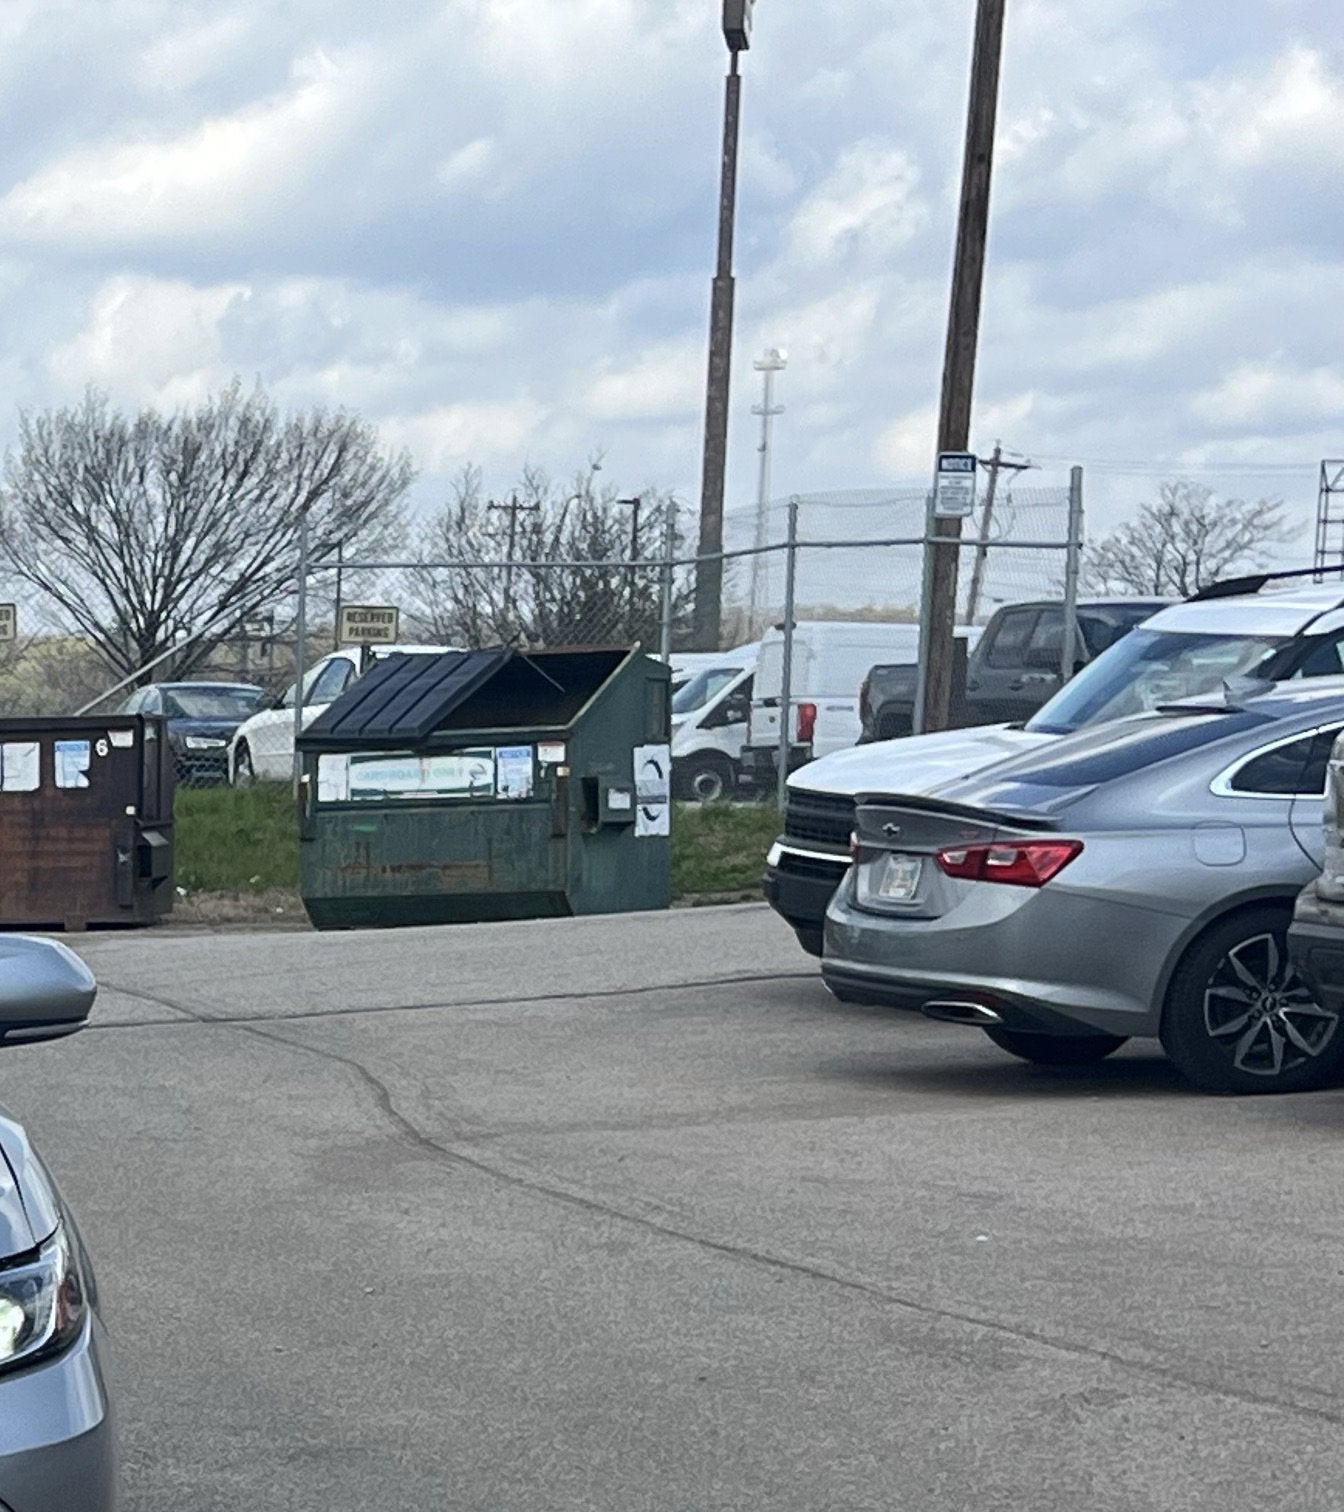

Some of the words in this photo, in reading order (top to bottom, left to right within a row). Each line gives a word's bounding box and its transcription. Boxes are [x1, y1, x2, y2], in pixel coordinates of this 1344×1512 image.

[346, 611, 393, 624] RESERVED
[349, 626, 389, 639] PARKING
[95, 738, 109, 757] 6
